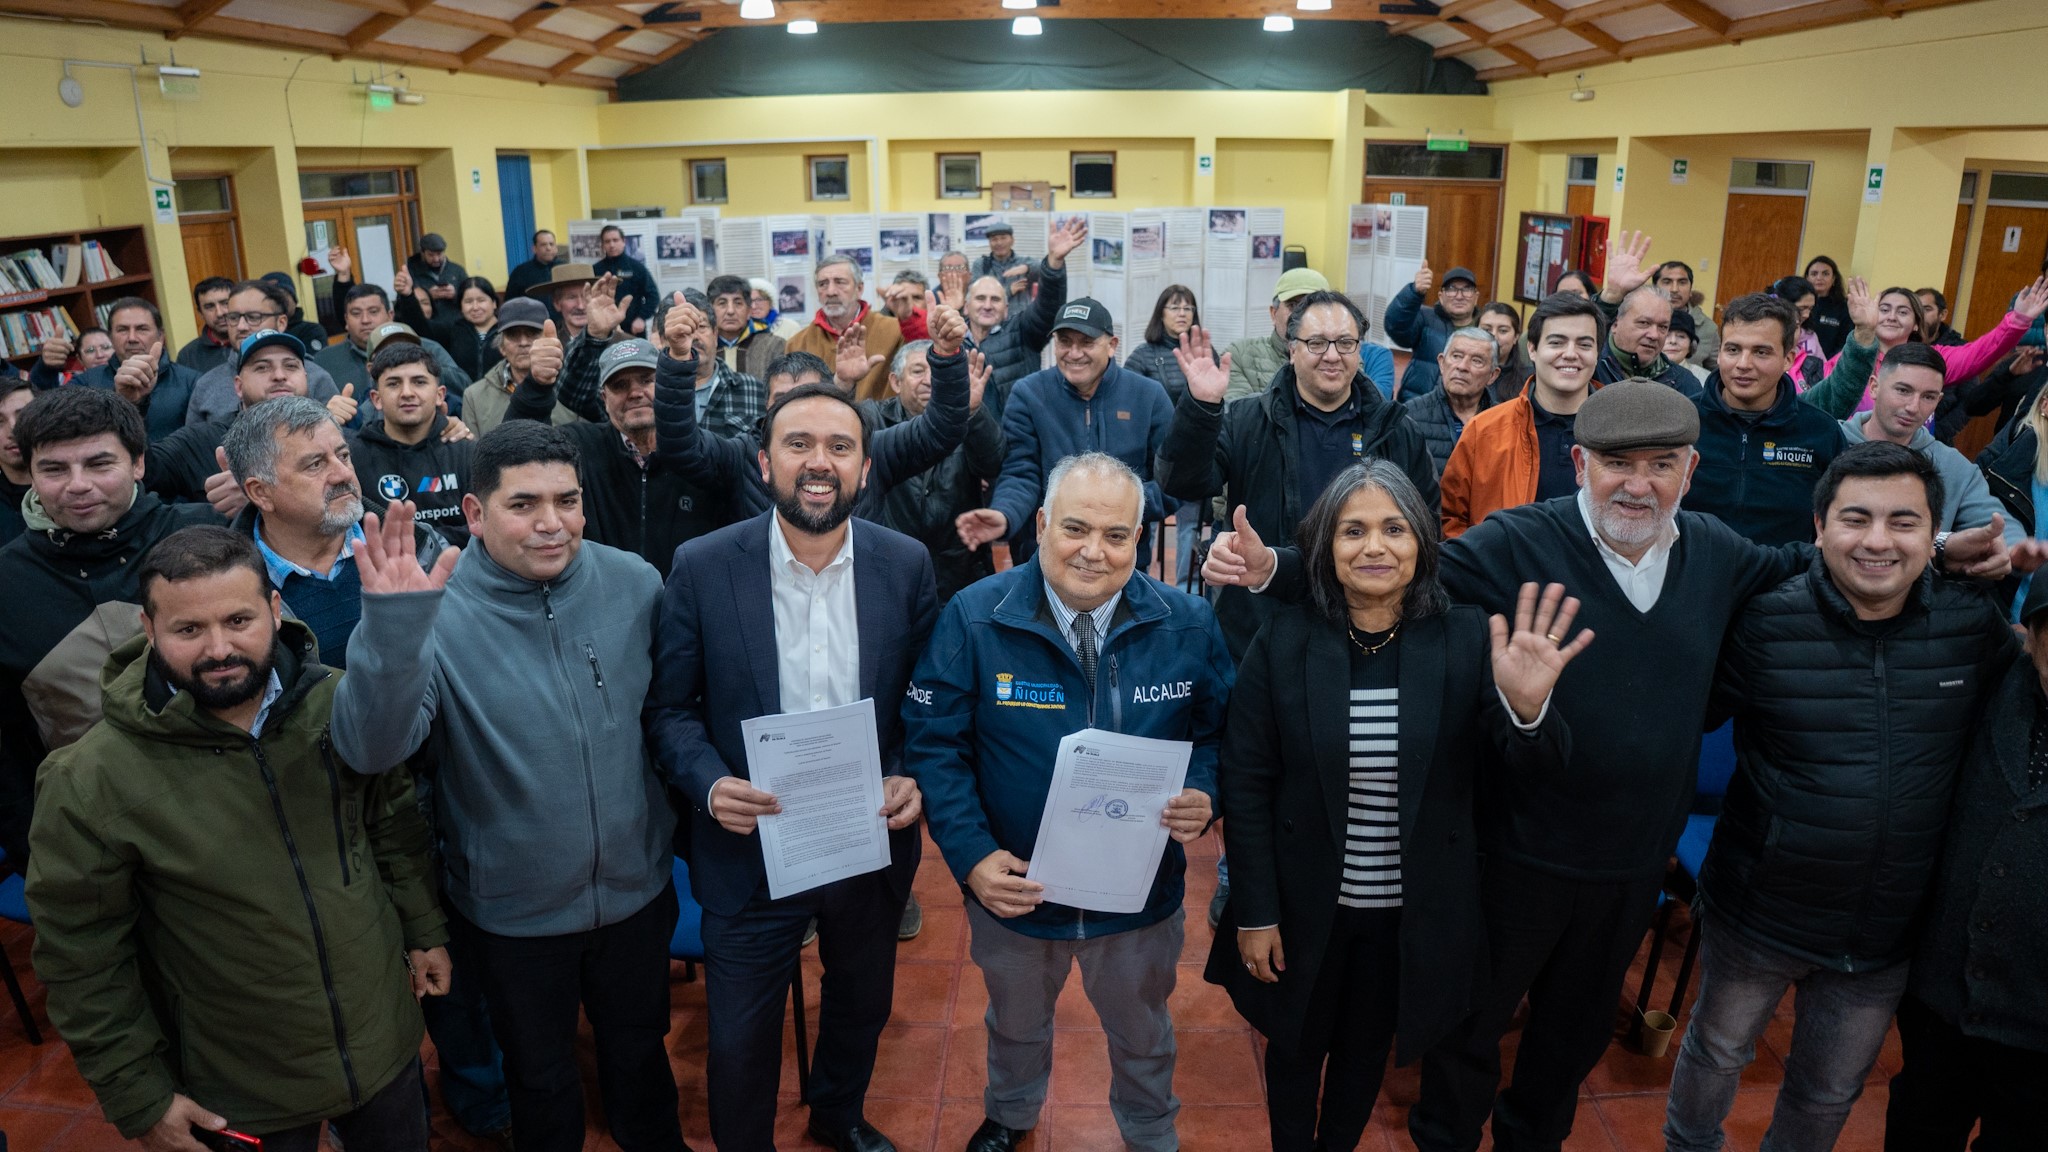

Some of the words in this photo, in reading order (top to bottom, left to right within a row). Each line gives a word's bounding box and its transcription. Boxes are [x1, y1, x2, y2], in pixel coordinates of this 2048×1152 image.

[1776, 451, 1813, 463] ÑIQUÉN
[412, 504, 460, 520] orsport
[1015, 686, 1065, 703] ÑIQUÉN
[1133, 681, 1193, 704] ALCALDE
